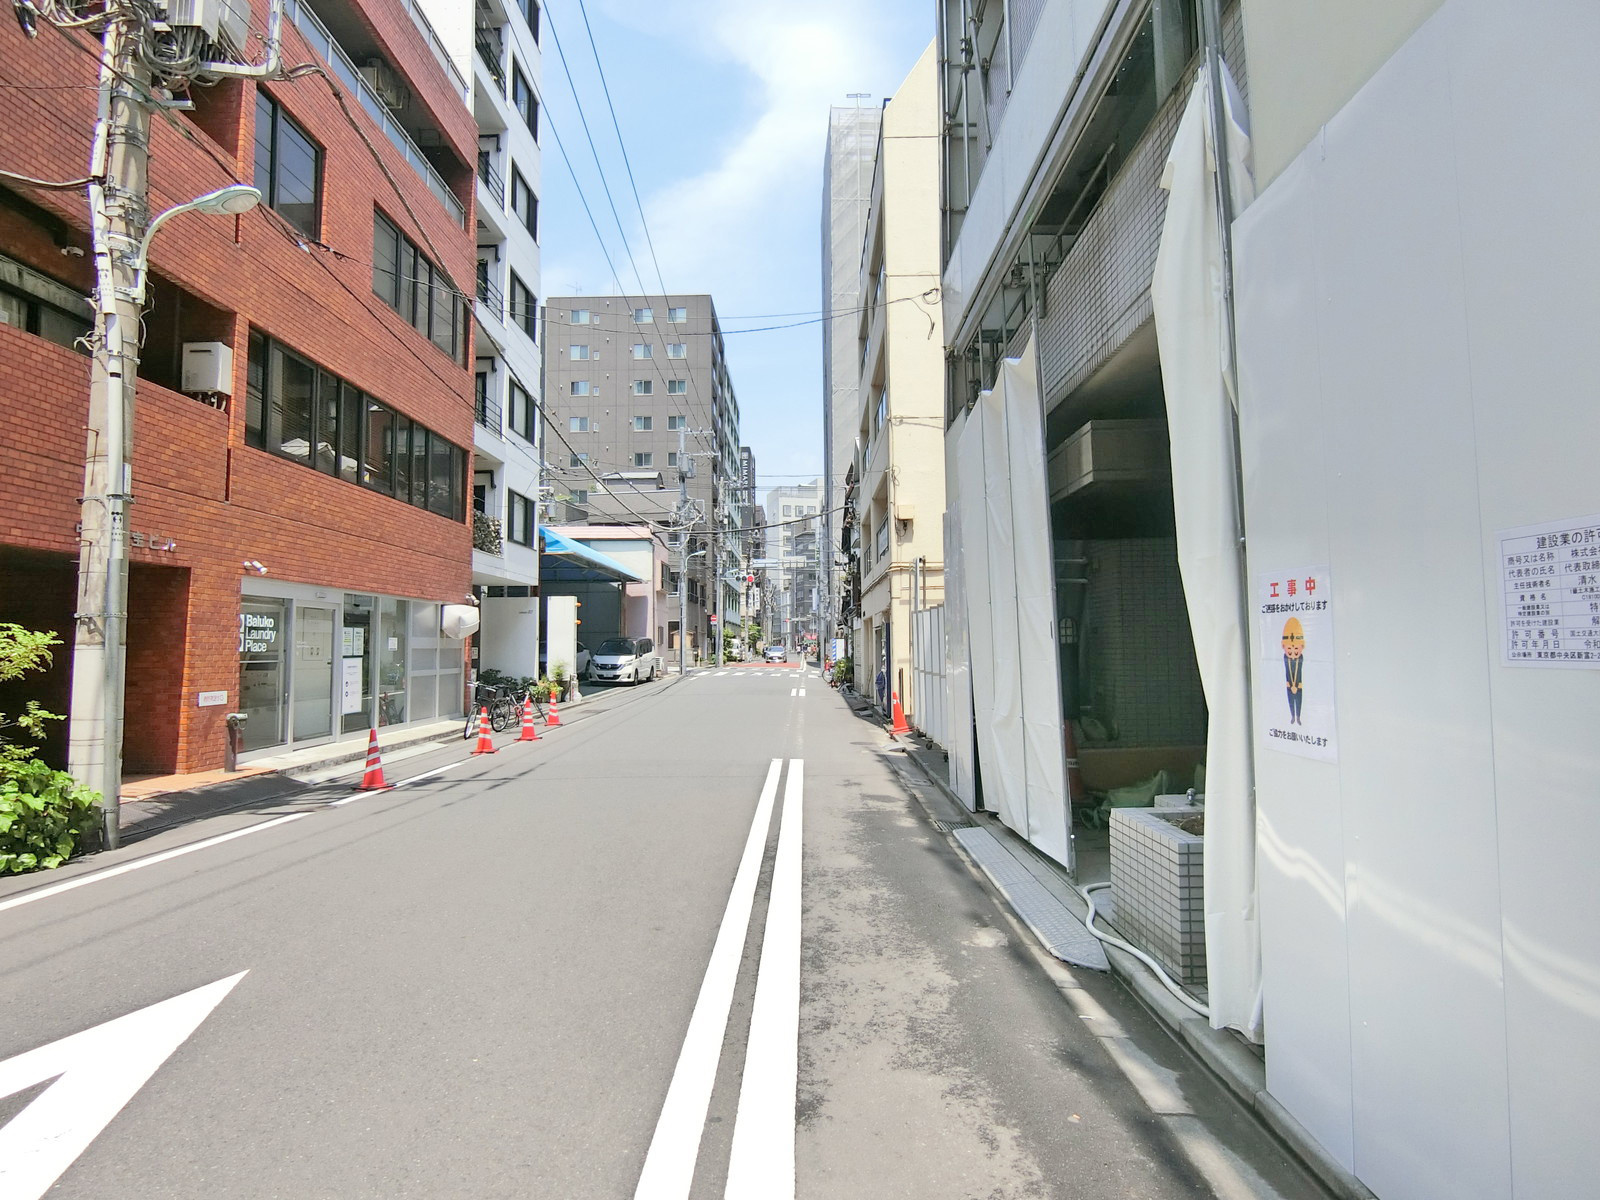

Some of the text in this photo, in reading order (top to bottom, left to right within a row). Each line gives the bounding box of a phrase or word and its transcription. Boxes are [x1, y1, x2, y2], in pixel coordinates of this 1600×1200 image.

[1571, 545, 1600, 558] 株式会
[1507, 551, 1554, 566] 商号又は名称
[1508, 565, 1555, 578] 代表者の氏名
[1514, 579, 1551, 590] 主任技術者名
[1578, 574, 1597, 586] 清水
[1269, 576, 1316, 598] 工事中
[1520, 592, 1547, 602] 資格名
[1261, 600, 1328, 613] ご迷惑をおかけしております
[246, 614, 274, 628] Baluko
[1510, 619, 1559, 627] 許可を受けた建設業
[246, 627, 276, 642] Laundry
[1512, 628, 1559, 639] 許可番号
[245, 640, 267, 652] Place
[1511, 640, 1560, 650] 許可年月日
[1269, 728, 1328, 747] ご協力をお願いいたします
